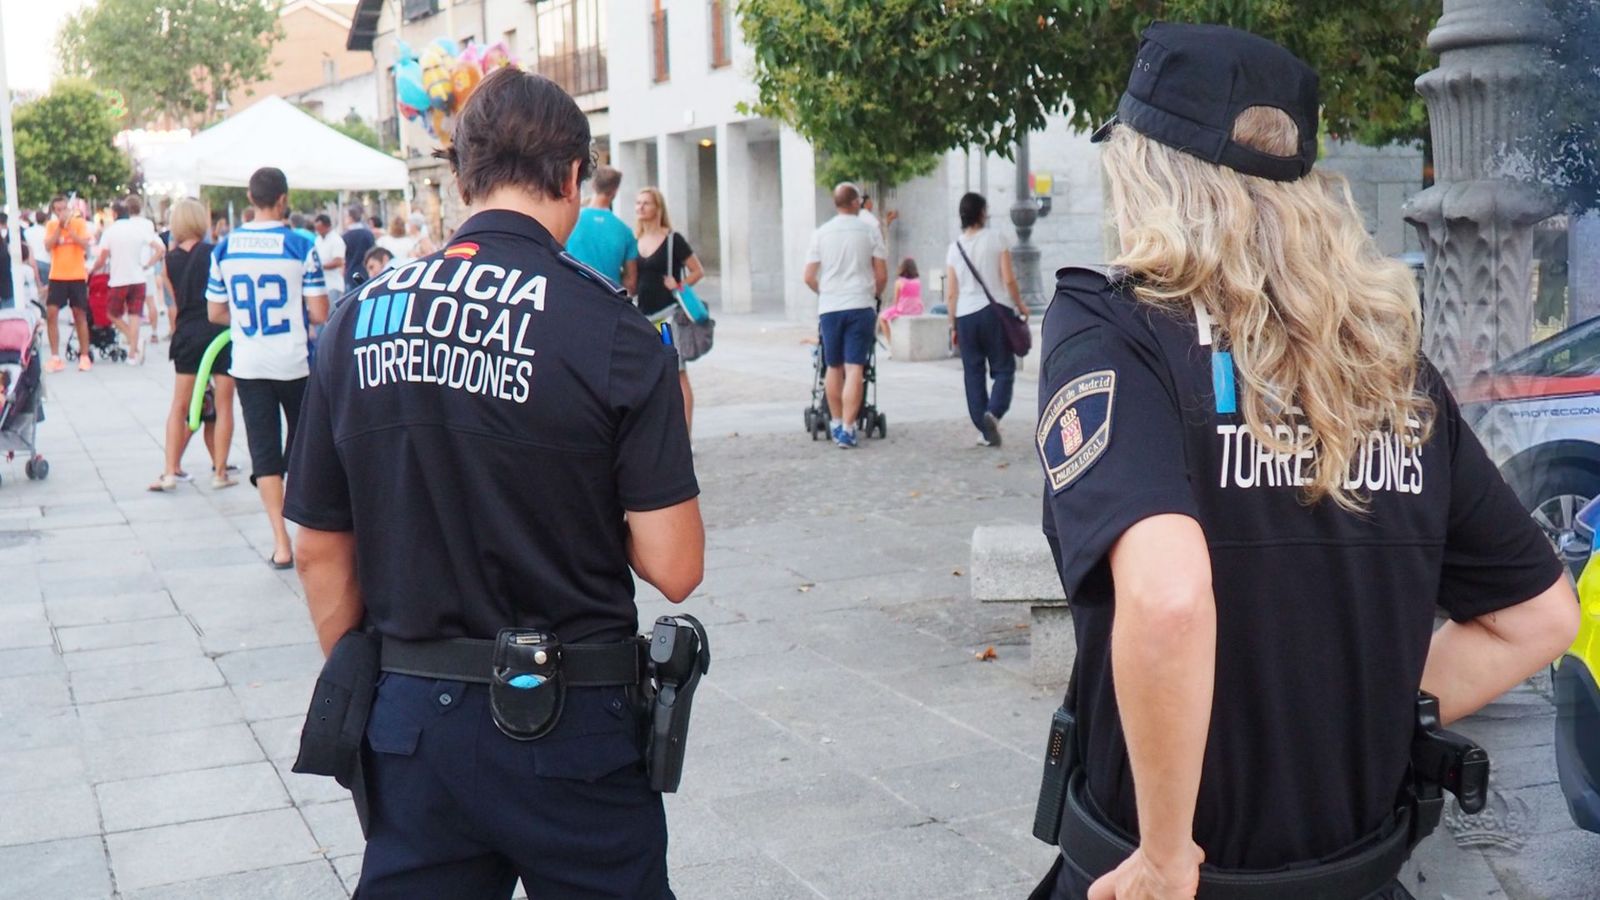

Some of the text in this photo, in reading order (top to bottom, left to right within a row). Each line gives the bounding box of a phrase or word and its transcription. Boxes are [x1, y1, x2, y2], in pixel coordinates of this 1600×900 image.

[230, 273, 291, 338] 92
[358, 259, 547, 311] POLICIA
[402, 293, 536, 356] LOCAL
[354, 338, 532, 404] TORRELODONES
[1078, 377, 1110, 392] Madrid
[1079, 439, 1103, 465] LOCAL
[1217, 425, 1423, 494] TORREDONES
